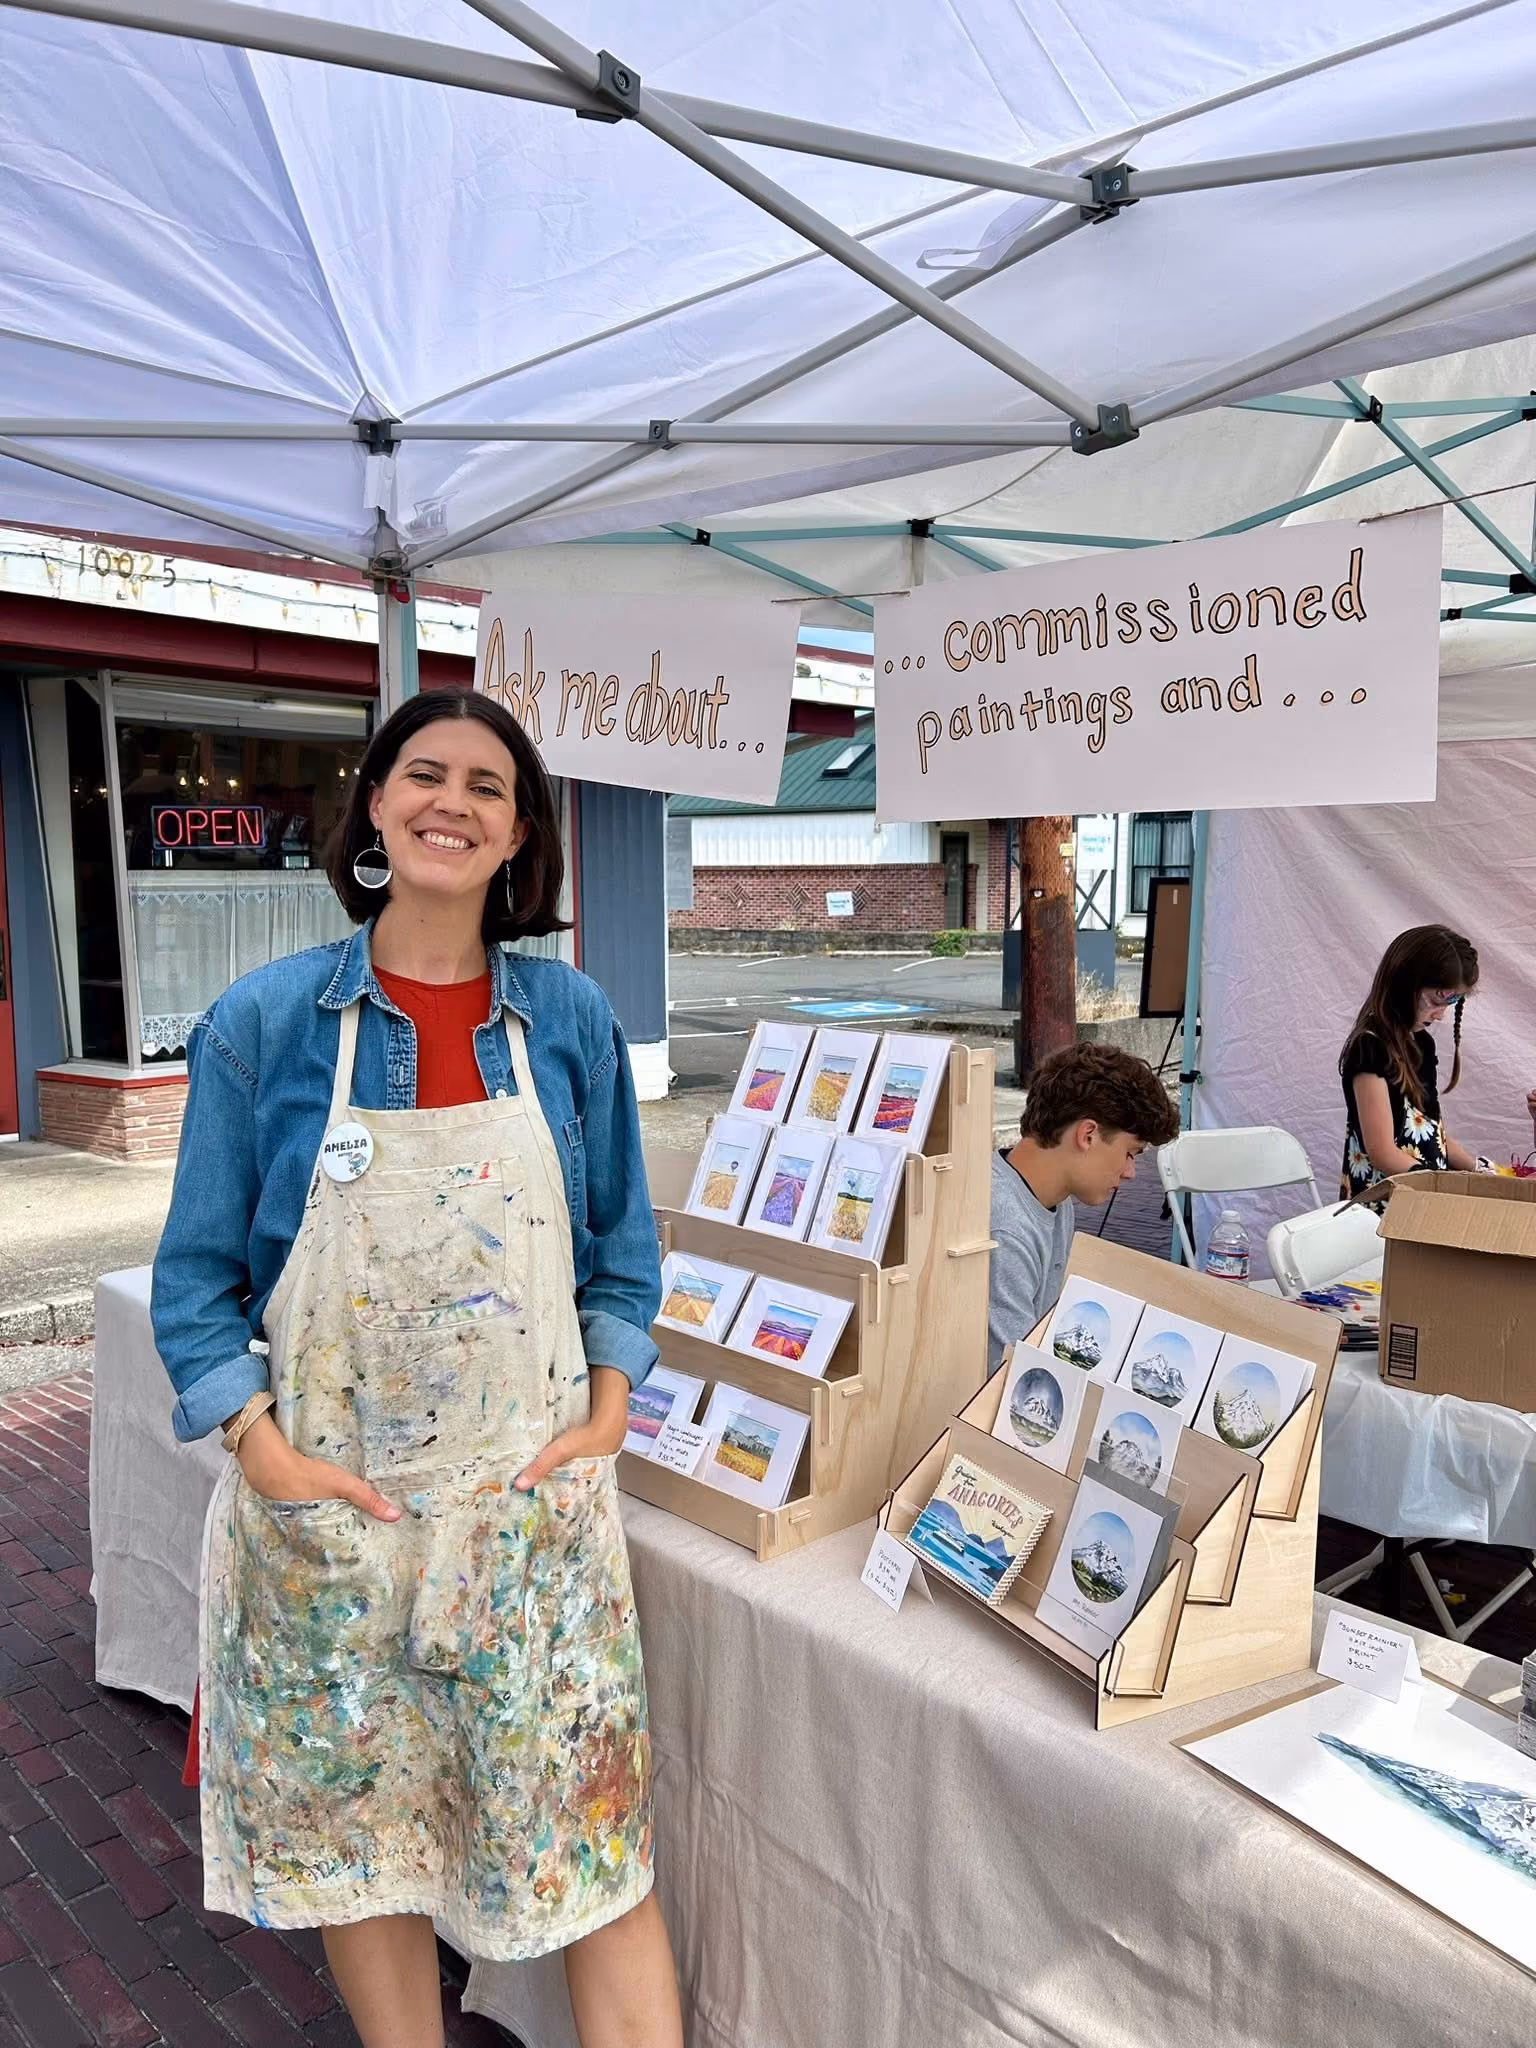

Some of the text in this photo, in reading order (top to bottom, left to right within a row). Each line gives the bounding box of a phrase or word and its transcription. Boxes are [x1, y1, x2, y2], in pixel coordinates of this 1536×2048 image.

[482, 617, 546, 745] Ask
[556, 669, 620, 740] me
[917, 684, 1133, 775] paintings
[1160, 654, 1263, 714] and
[158, 810, 260, 845] OPEN
[324, 1138, 368, 1153] AMELIA
[947, 1483, 1024, 1530] ANACORTES
